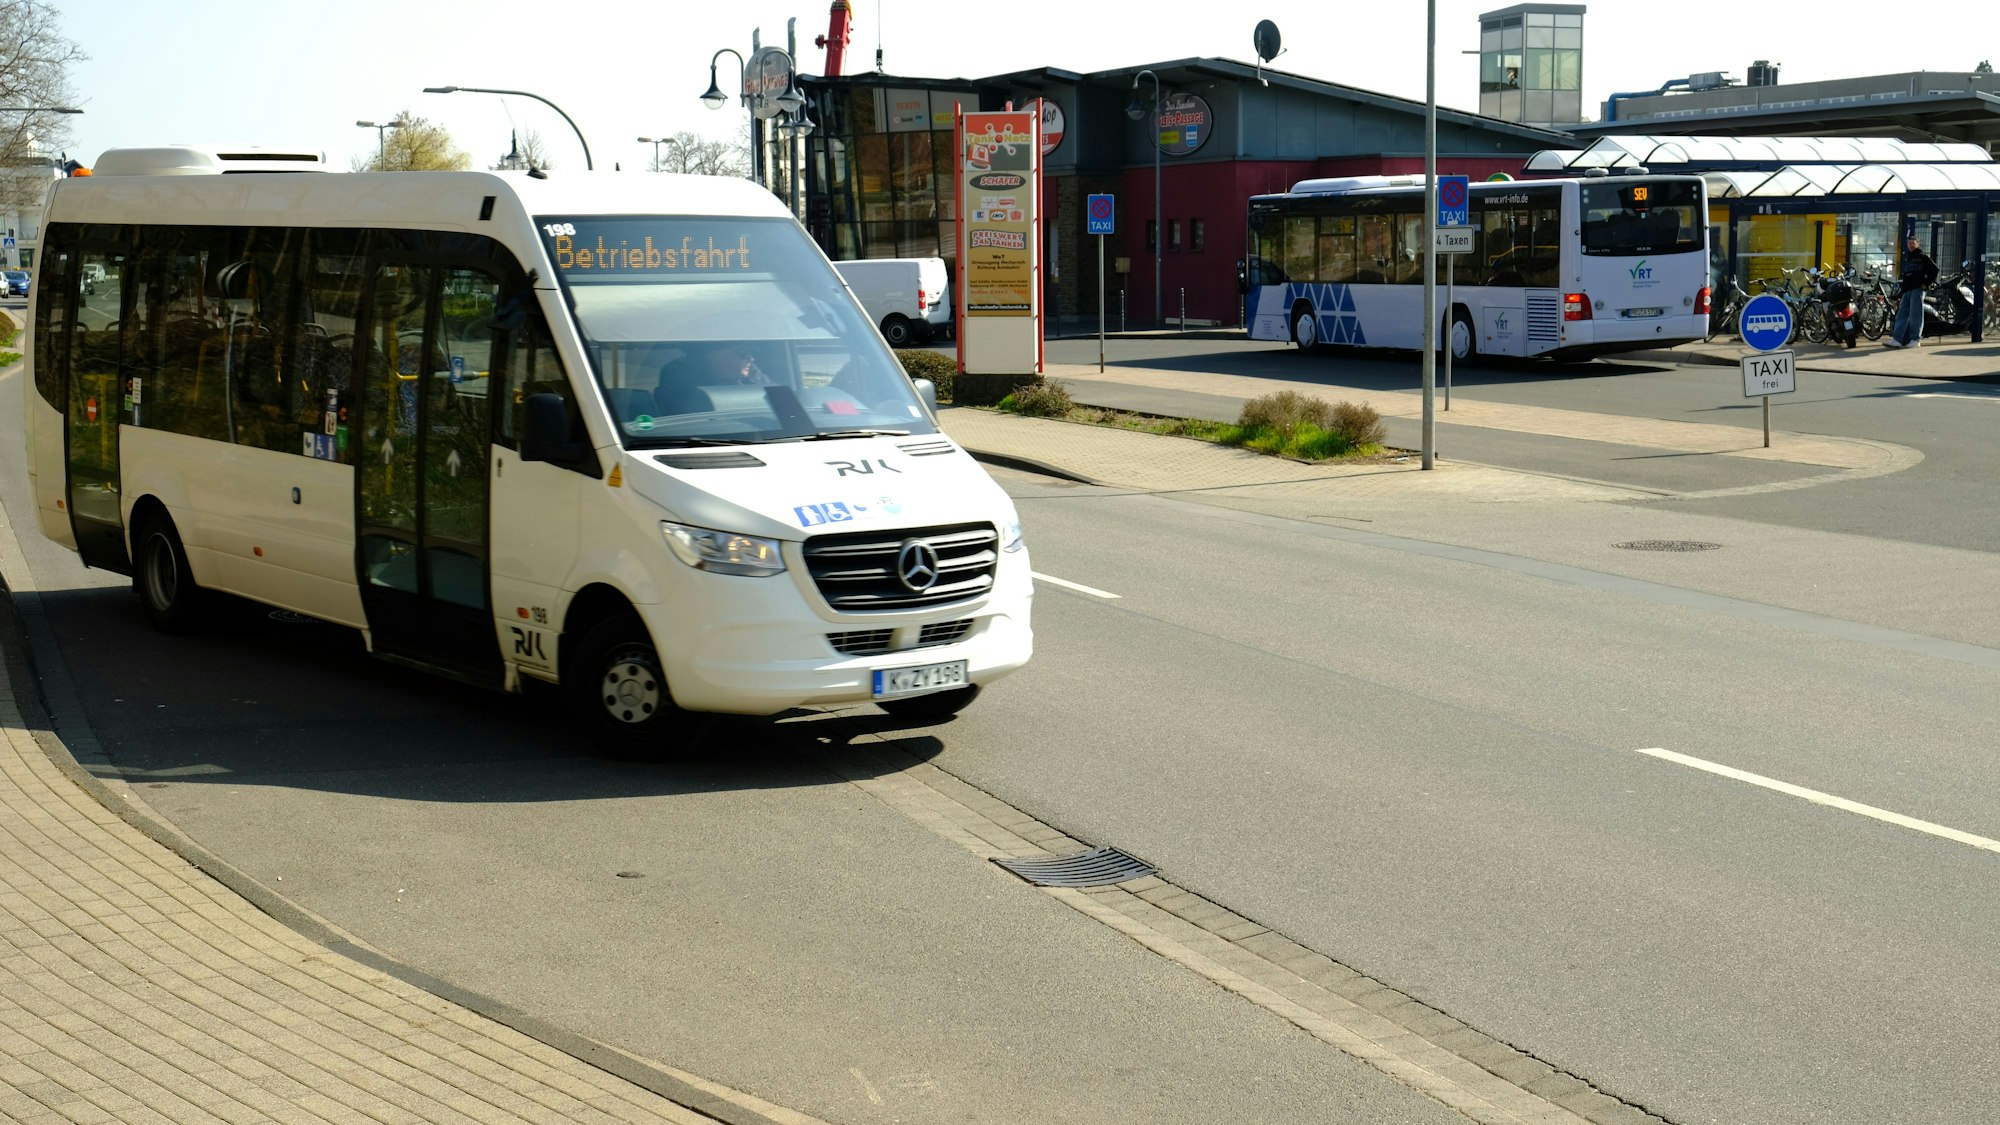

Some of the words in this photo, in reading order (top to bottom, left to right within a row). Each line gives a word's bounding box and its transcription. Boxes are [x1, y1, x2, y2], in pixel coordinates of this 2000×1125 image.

[1042, 107, 1057, 125] hop
[966, 132, 995, 145] Tank
[1004, 132, 1031, 145] Netz
[1484, 194, 1529, 205] www.vrt-info.de
[1633, 187, 1648, 201] SEV
[1440, 210, 1465, 221] TAXI
[543, 223, 576, 237] 198
[1090, 221, 1111, 231] TAXI
[972, 230, 1024, 241] PREISWERT
[1445, 234, 1469, 246] Taxen
[973, 238, 990, 247] 24h
[991, 239, 1024, 249] TANKEN
[556, 235, 750, 269] Betriebsfahrt
[1629, 260, 1653, 279] VRT
[1494, 311, 1508, 330] VRT
[1750, 358, 1788, 377] TAXI
[1762, 379, 1779, 389] frei
[531, 606, 548, 624] 198
[933, 664, 961, 685] 198
